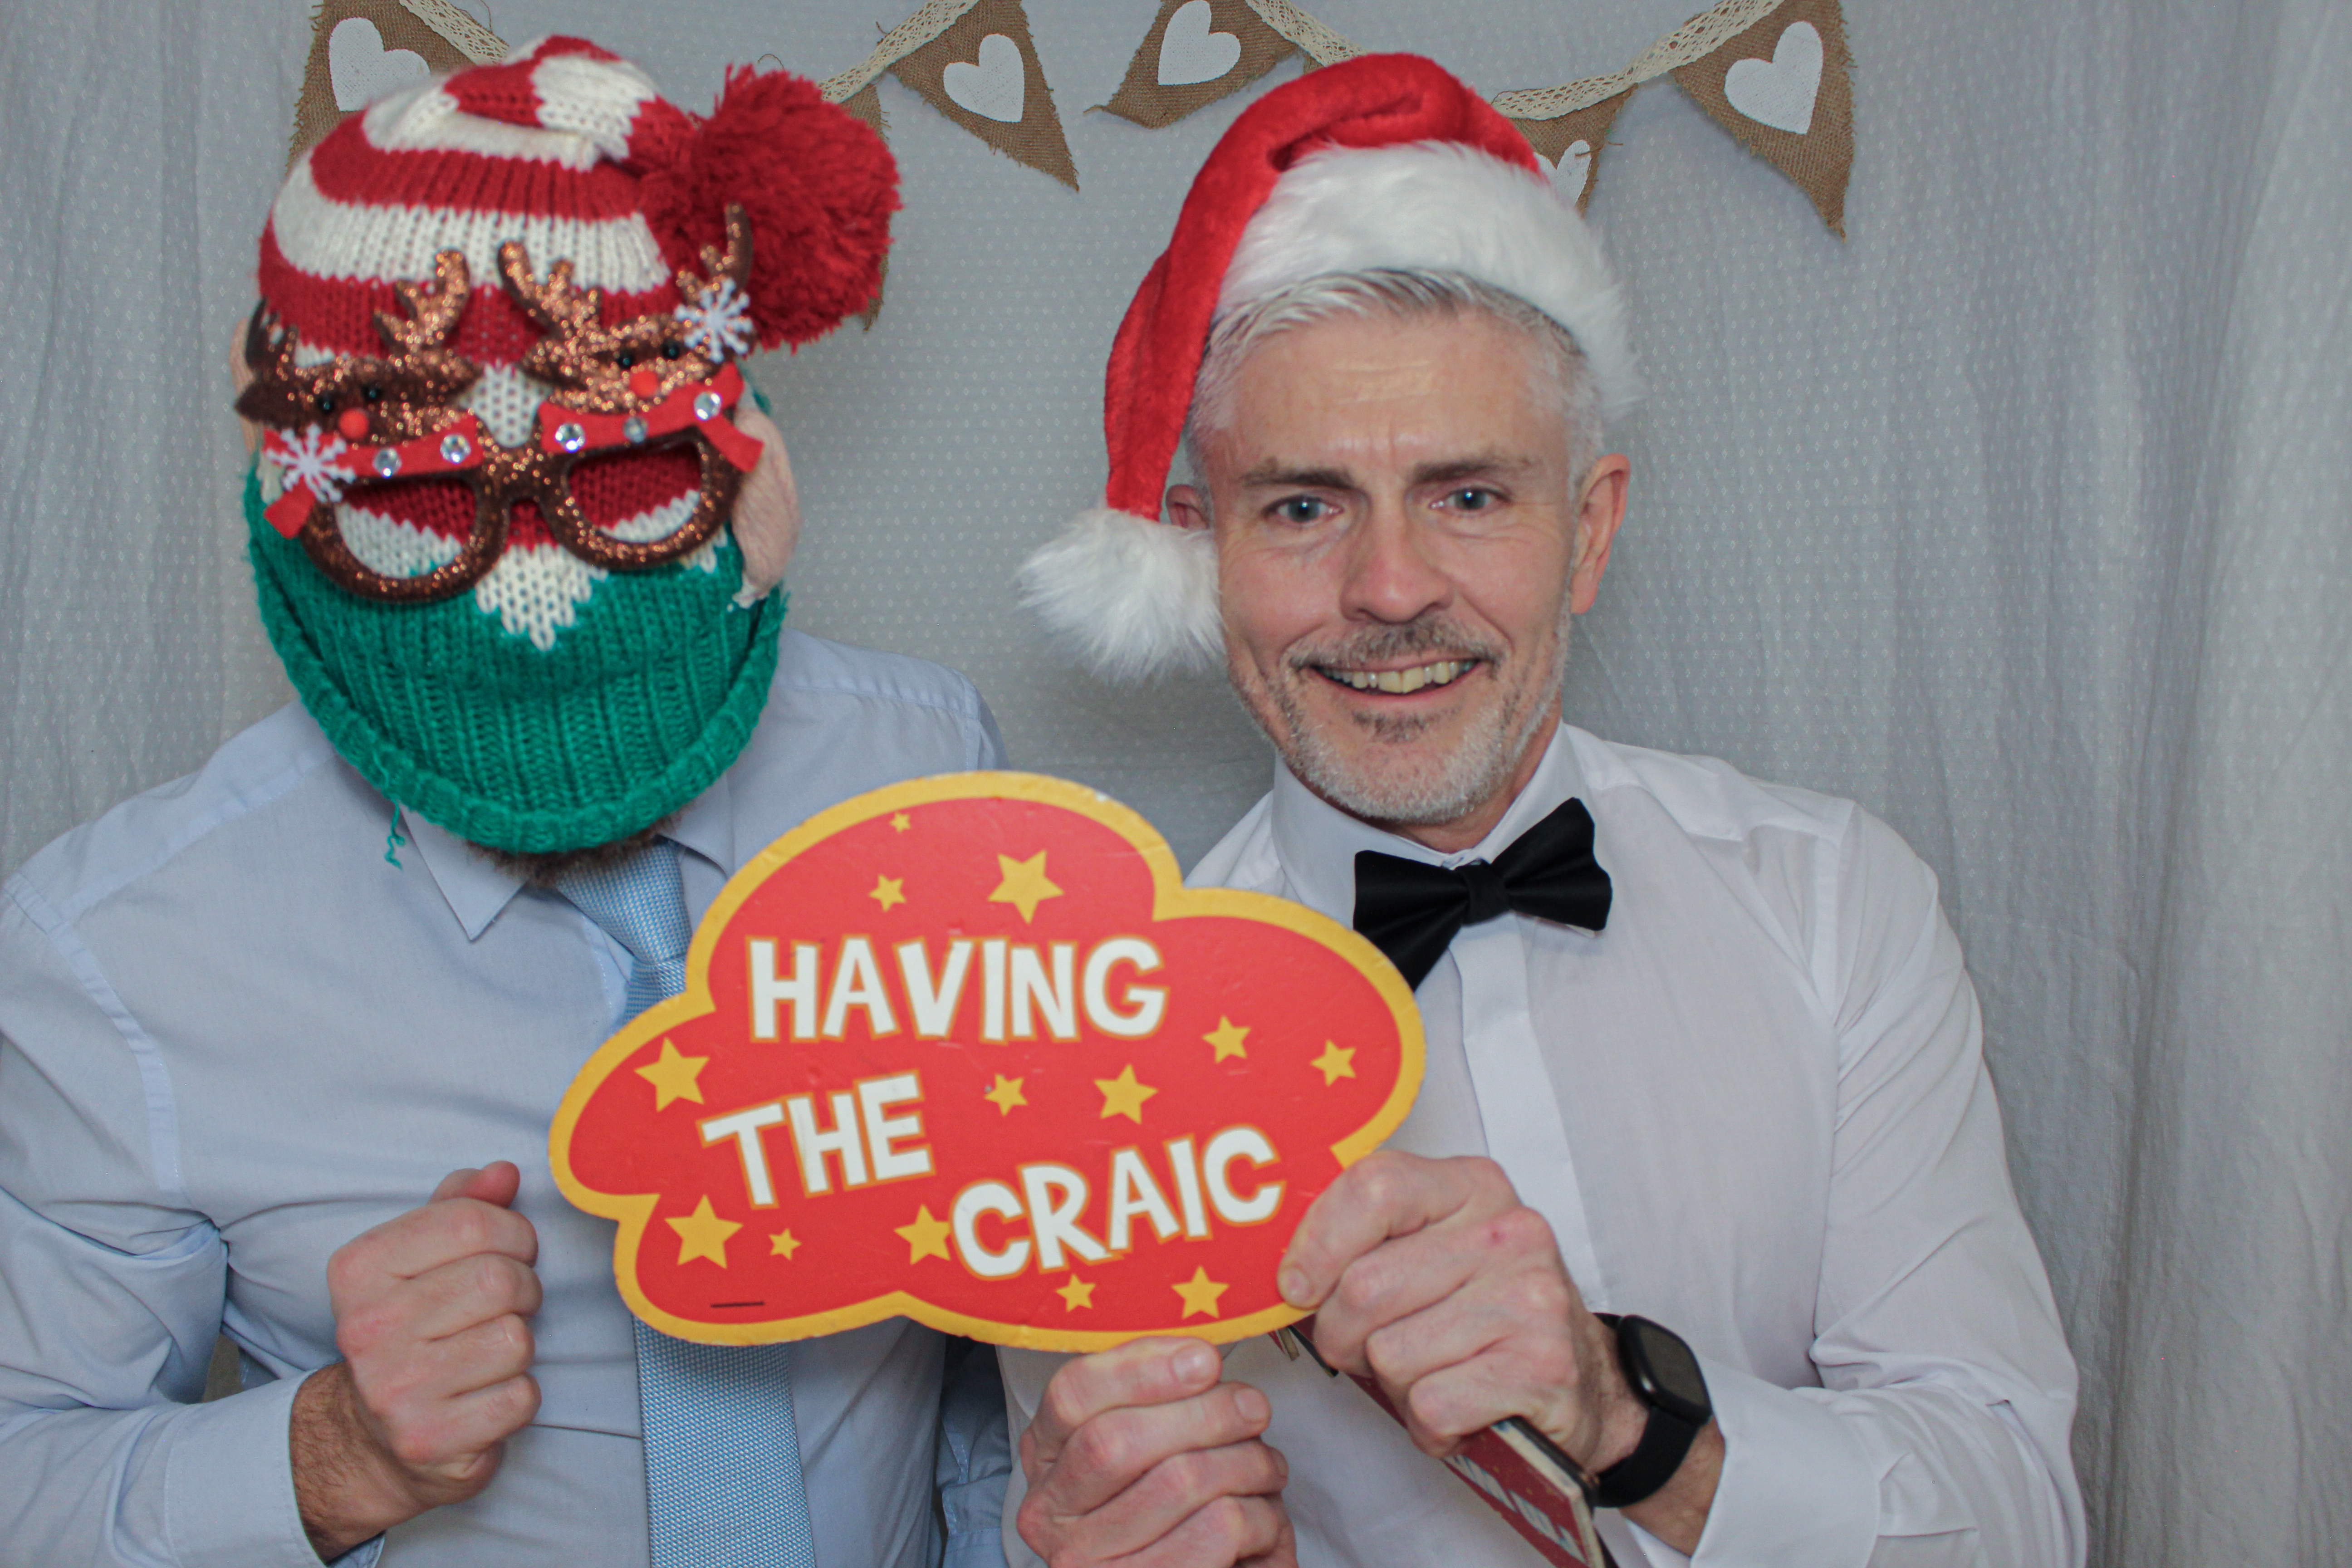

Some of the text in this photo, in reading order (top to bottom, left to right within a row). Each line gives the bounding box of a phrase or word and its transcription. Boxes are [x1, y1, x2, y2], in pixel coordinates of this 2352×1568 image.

[750, 937, 1166, 1042] HAVING
[701, 1073, 932, 1205] THE
[952, 1127, 1282, 1277] CRAIC
